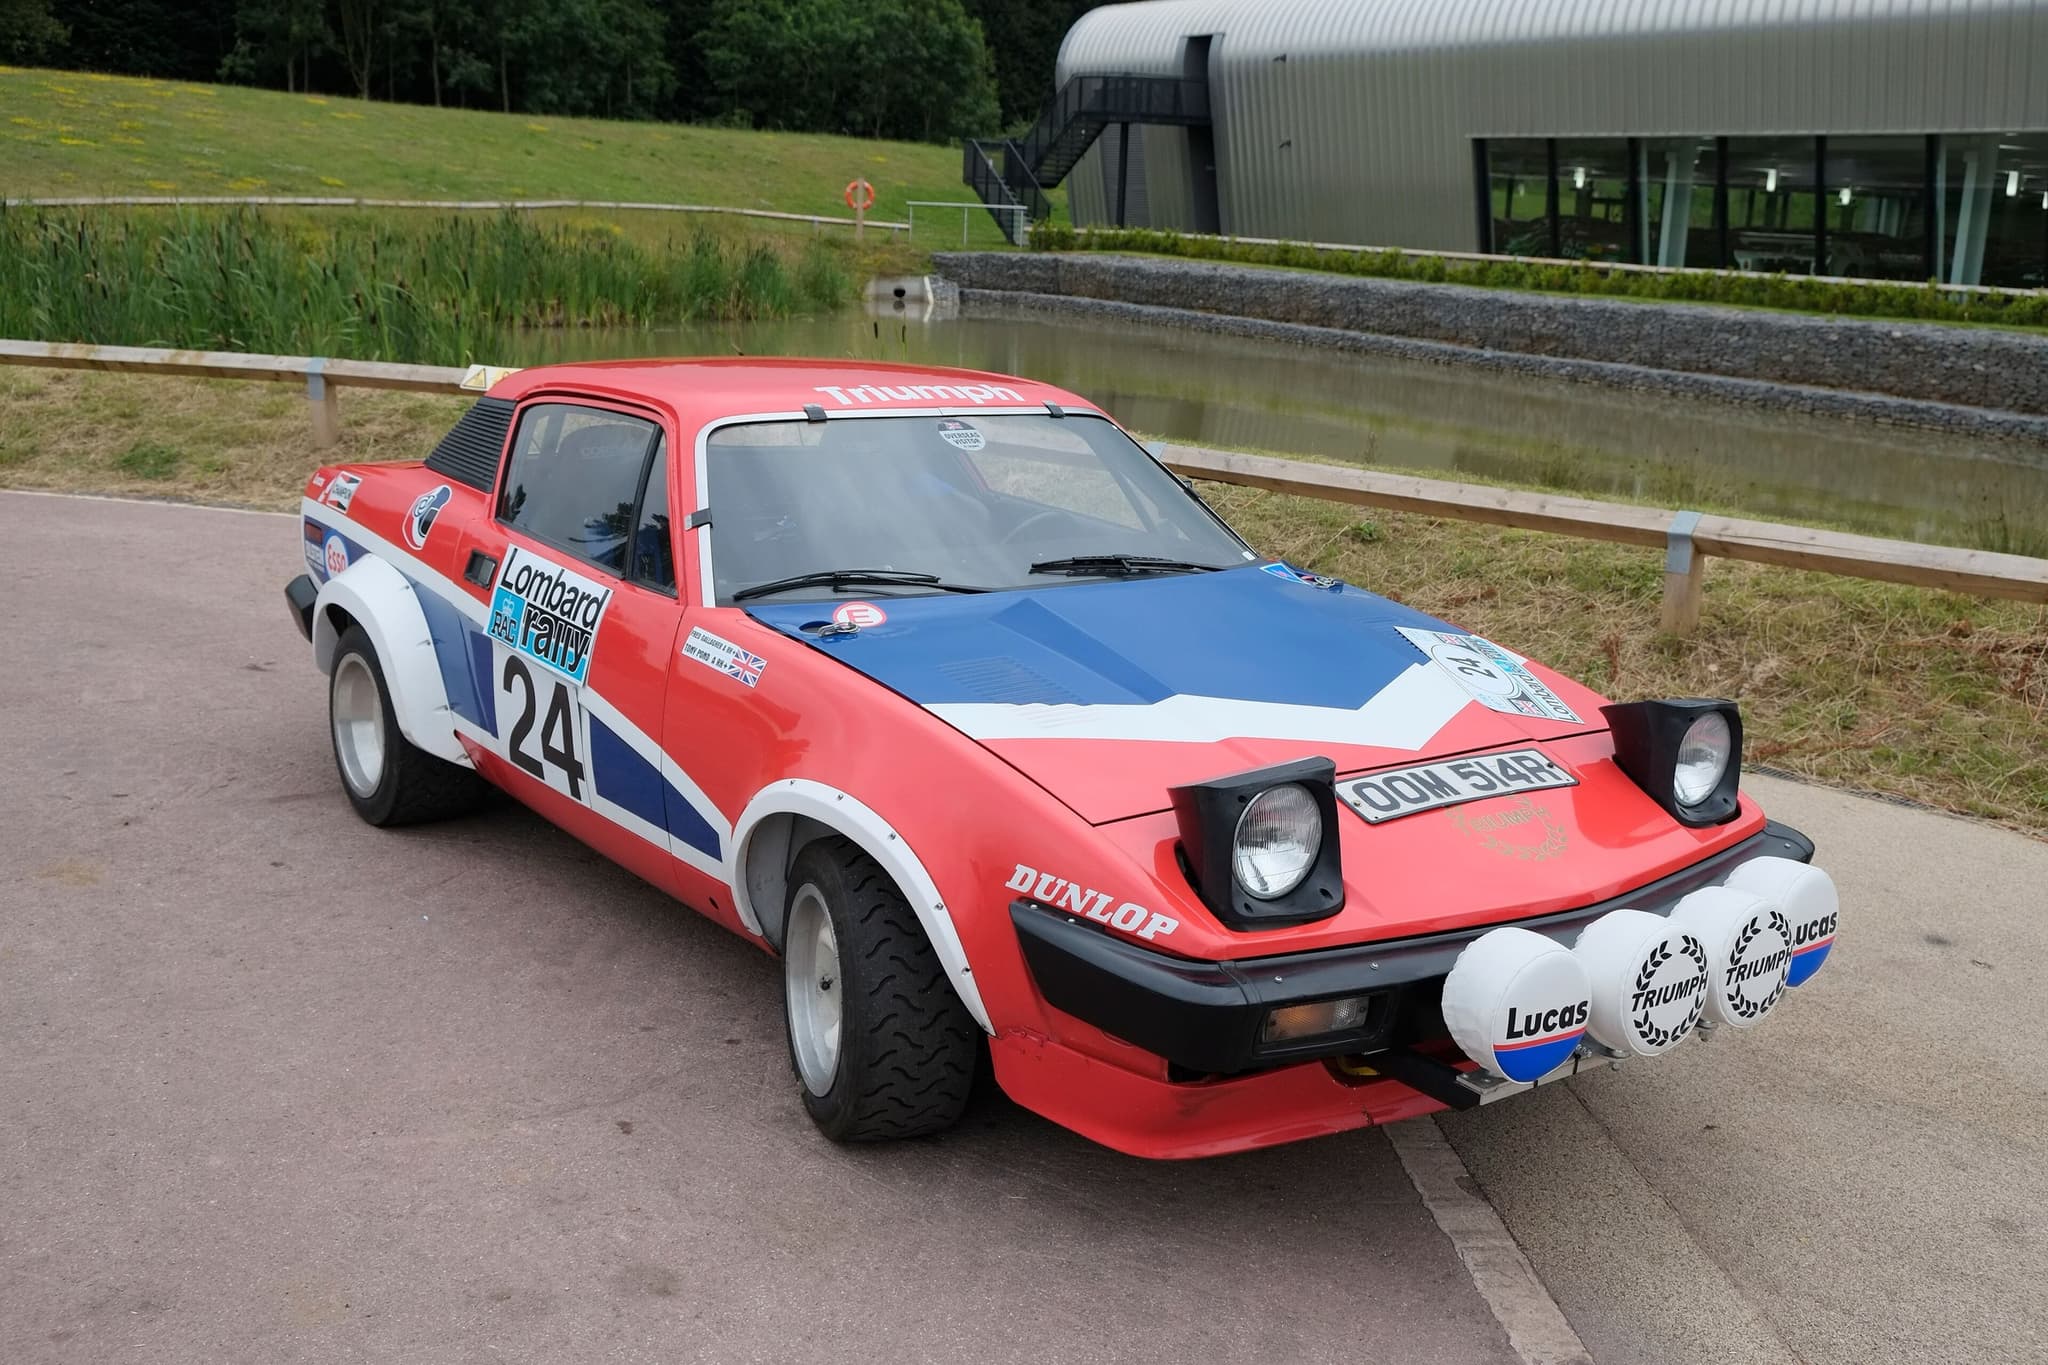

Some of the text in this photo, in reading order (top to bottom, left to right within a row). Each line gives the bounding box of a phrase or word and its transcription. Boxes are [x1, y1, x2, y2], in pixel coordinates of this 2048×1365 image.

[813, 384, 1025, 405] Triumph
[944, 432, 981, 440] OVERSEAS
[501, 548, 611, 631] Lombard
[491, 611, 517, 643] RAC
[845, 608, 871, 624] E
[521, 607, 592, 673] rally
[684, 643, 698, 655] TONY
[697, 648, 711, 661] POND
[1446, 656, 1498, 679] 24
[1511, 673, 1577, 722] Lombard
[503, 655, 585, 802] 24
[1352, 755, 1562, 812] OOM 514R
[1004, 863, 1180, 940] DUNLOP
[1791, 911, 1838, 946] ucas
[1725, 947, 1793, 987] TRIUMPH
[1630, 971, 1709, 1013] TRIUMPH
[1506, 1000, 1589, 1040] Lucas
